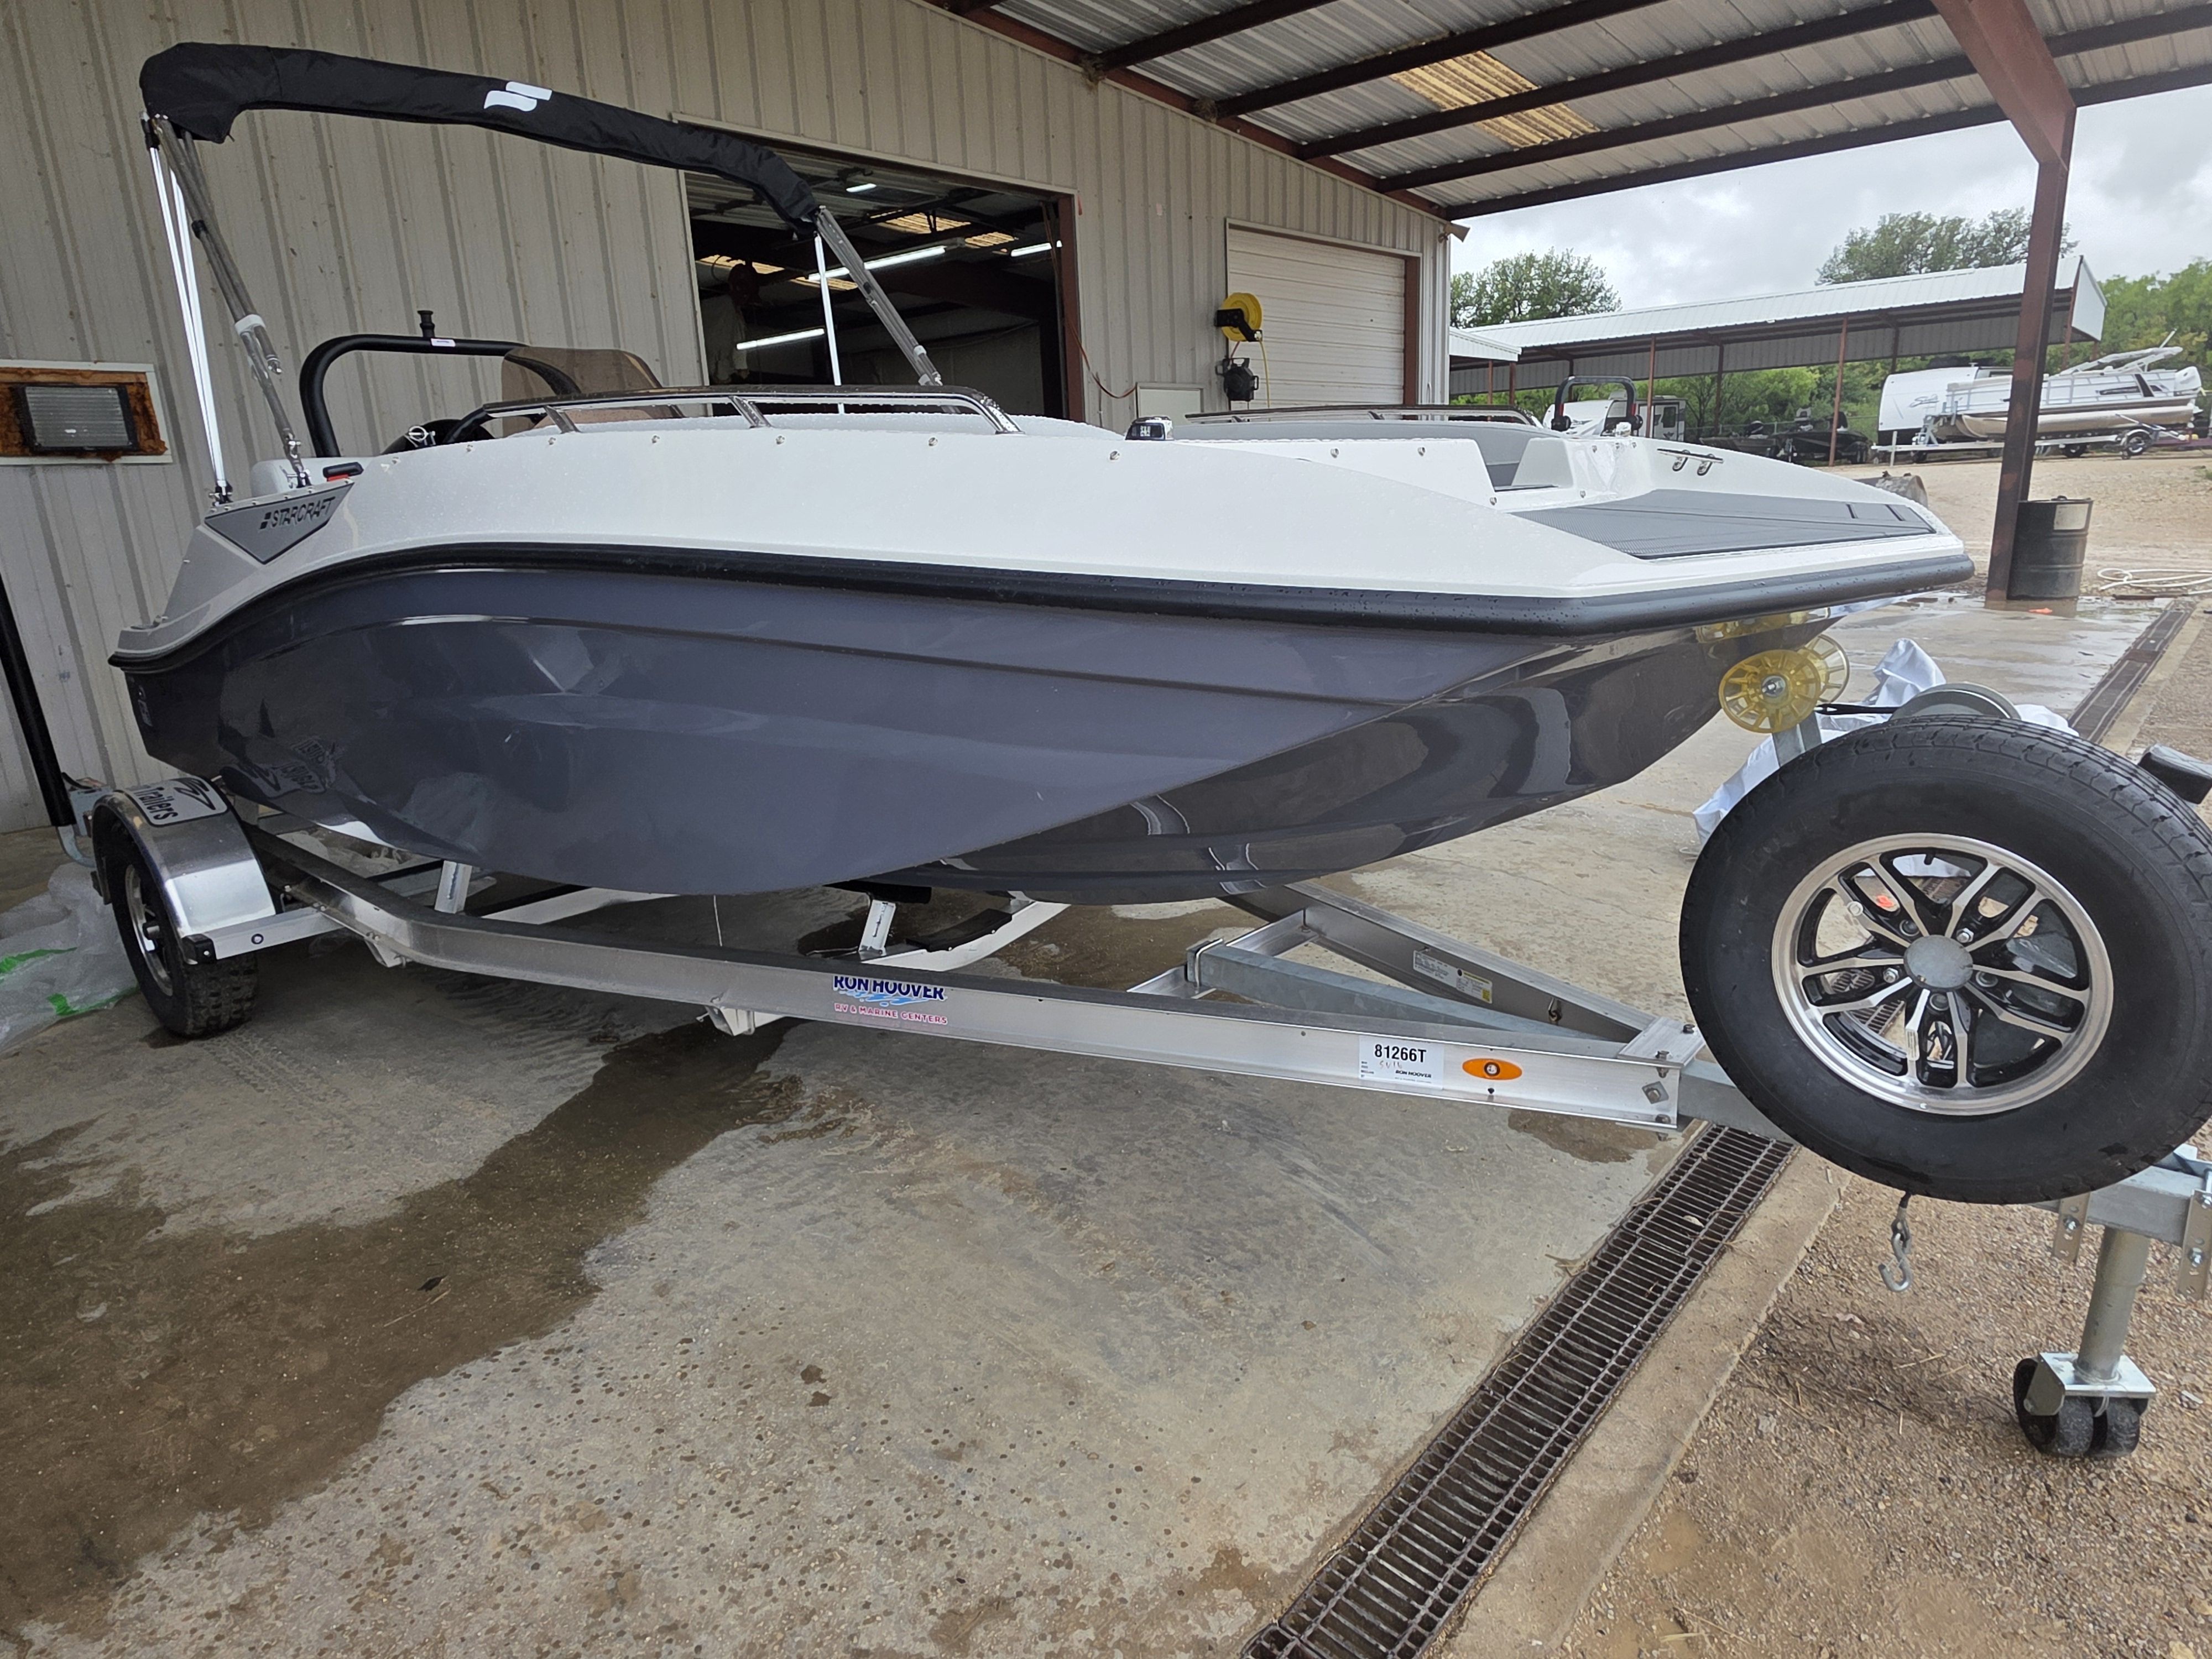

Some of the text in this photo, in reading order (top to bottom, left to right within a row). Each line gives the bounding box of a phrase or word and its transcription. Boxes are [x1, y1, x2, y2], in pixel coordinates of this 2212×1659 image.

[272, 497, 335, 527] STARCRAFT
[834, 975, 945, 1000] RON HOOVER
[834, 1003, 847, 1012] RV
[860, 1007, 898, 1018] MARINE
[901, 1012, 948, 1024] CENTERS
[1374, 1044, 1427, 1063] 81266T
